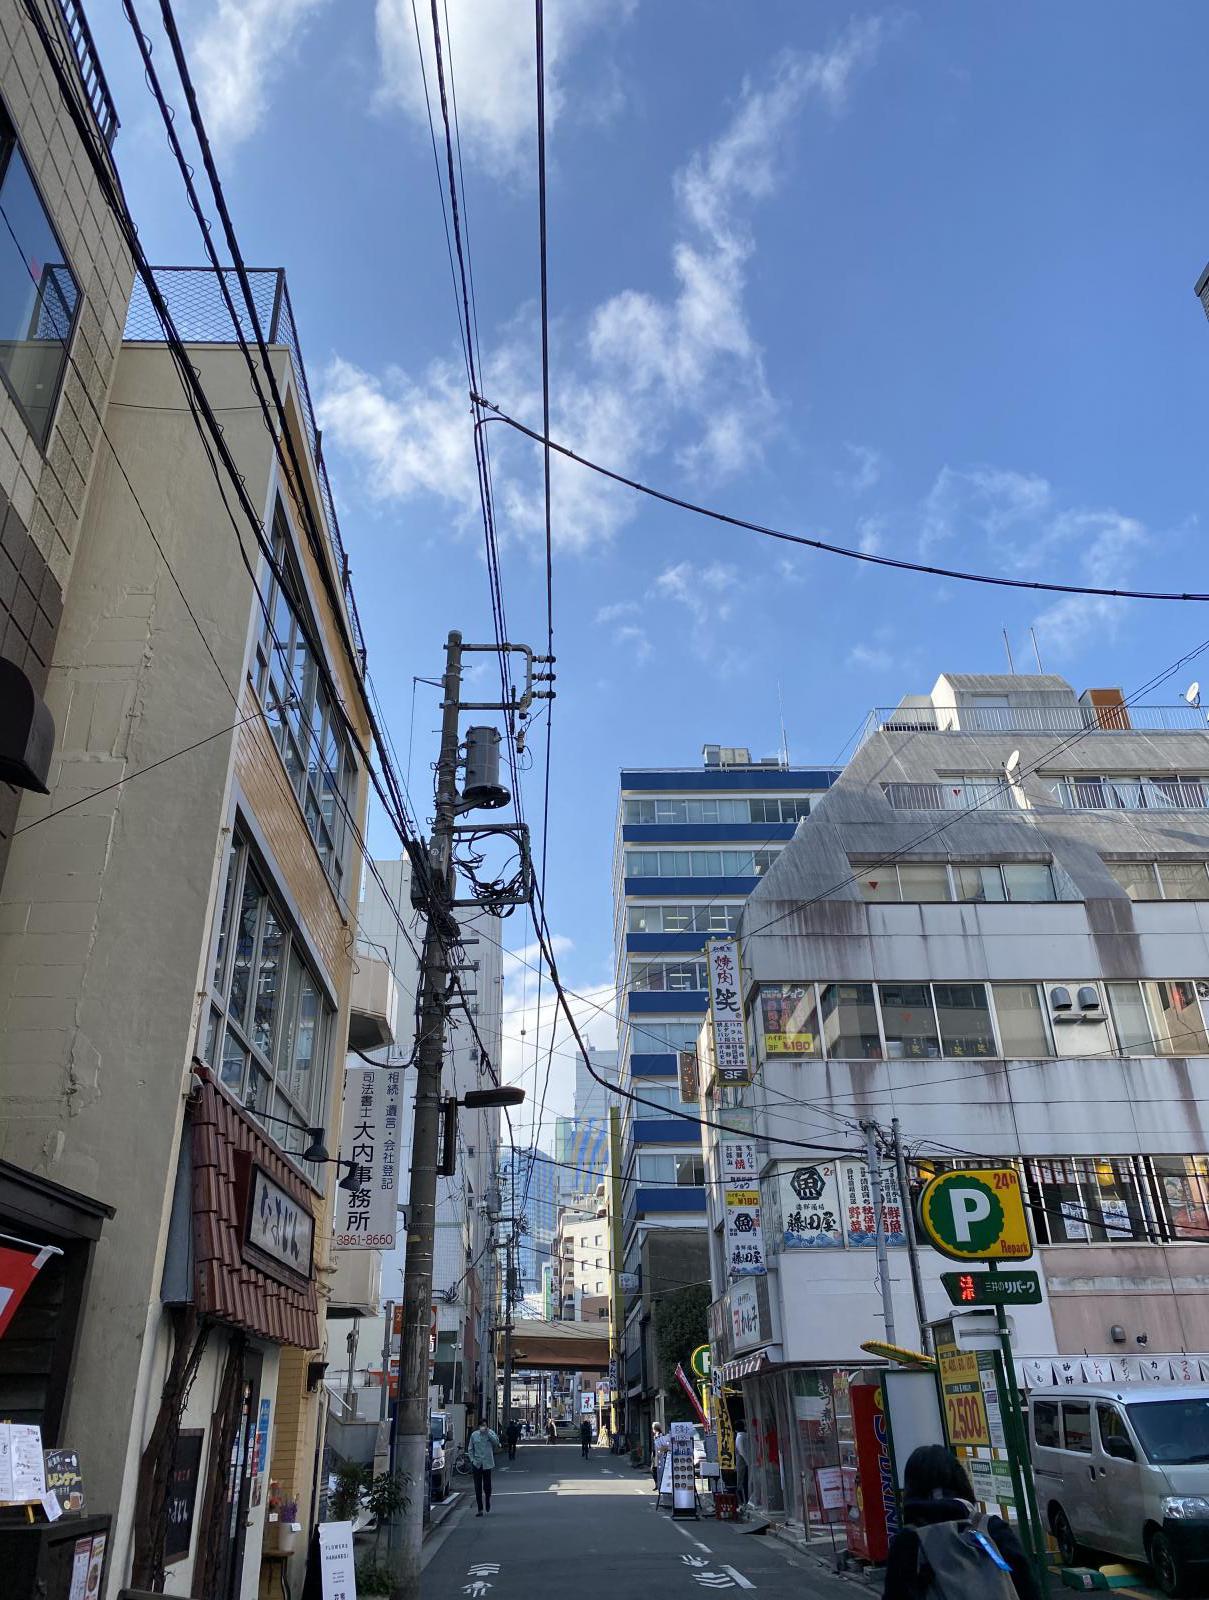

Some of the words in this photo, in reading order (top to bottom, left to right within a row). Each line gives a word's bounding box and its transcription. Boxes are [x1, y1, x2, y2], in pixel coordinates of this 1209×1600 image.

[714, 954, 735, 986] 焼肉
[715, 987, 741, 1013] 笑
[724, 1070, 743, 1080] 3F
[360, 1071, 375, 1118] 司法書士
[381, 1071, 400, 1190] 相続・遺言・会社登記
[346, 1120, 376, 1232] 大内事務所
[993, 1172, 1016, 1190] 24h
[786, 1210, 839, 1233] 藤田屋
[949, 1188, 991, 1243] P
[336, 1234, 393, 1246] 3861-8660
[1000, 1239, 1028, 1254] Repark
[985, 1280, 1036, 1295] 三井のリパーク
[1033, 1361, 1044, 1382] もも
[1061, 1363, 1073, 1385] 砂肝
[1180, 1361, 1191, 1381] つくね
[325, 1543, 348, 1551] FLOWERS
